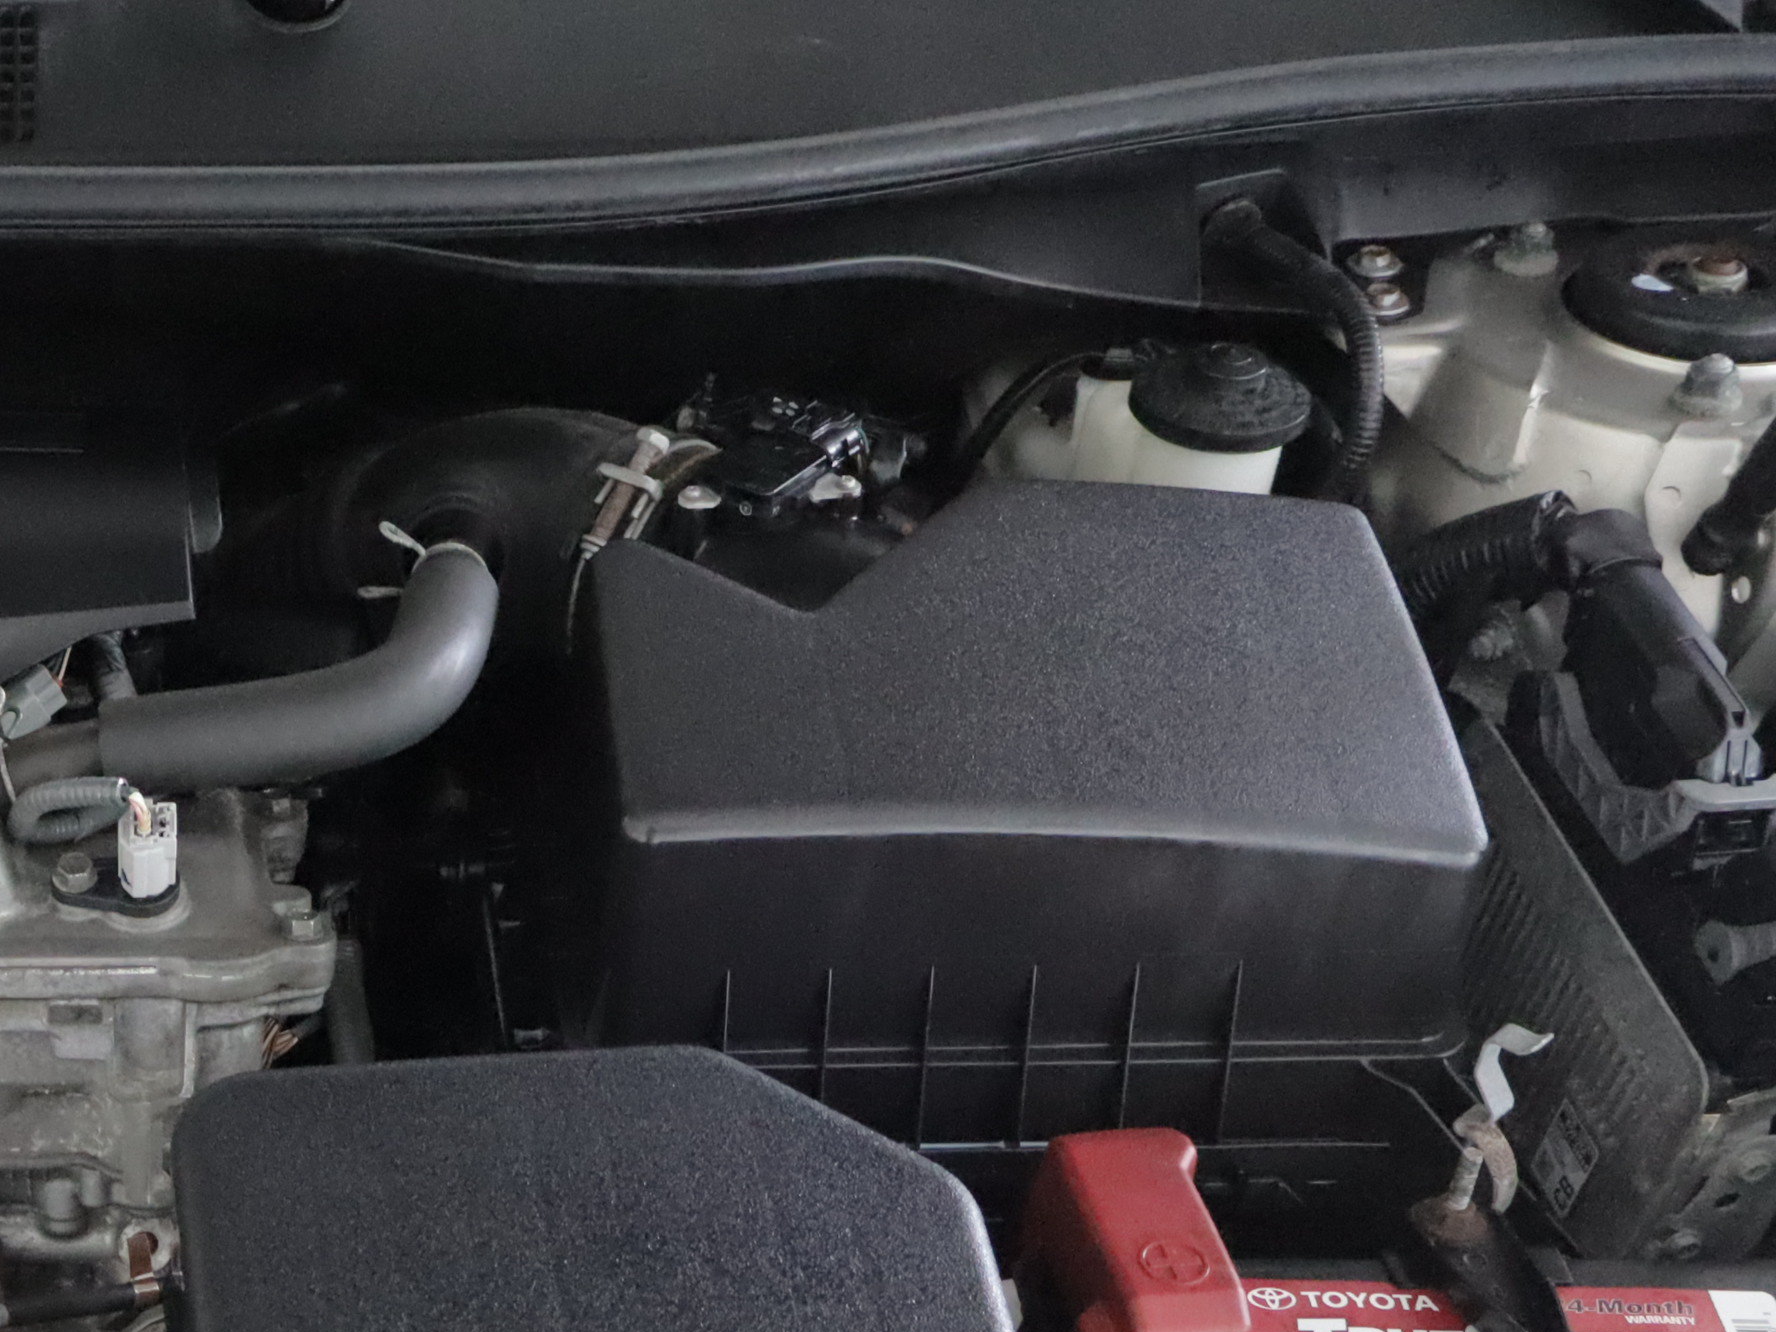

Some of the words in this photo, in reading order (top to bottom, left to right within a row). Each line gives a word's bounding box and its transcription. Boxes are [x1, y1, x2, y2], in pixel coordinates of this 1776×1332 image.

[1300, 1290, 1440, 1312] TOYOTA
[1562, 1298, 1694, 1316] 4-Month
[1625, 1315, 1696, 1326] WARRANTY
